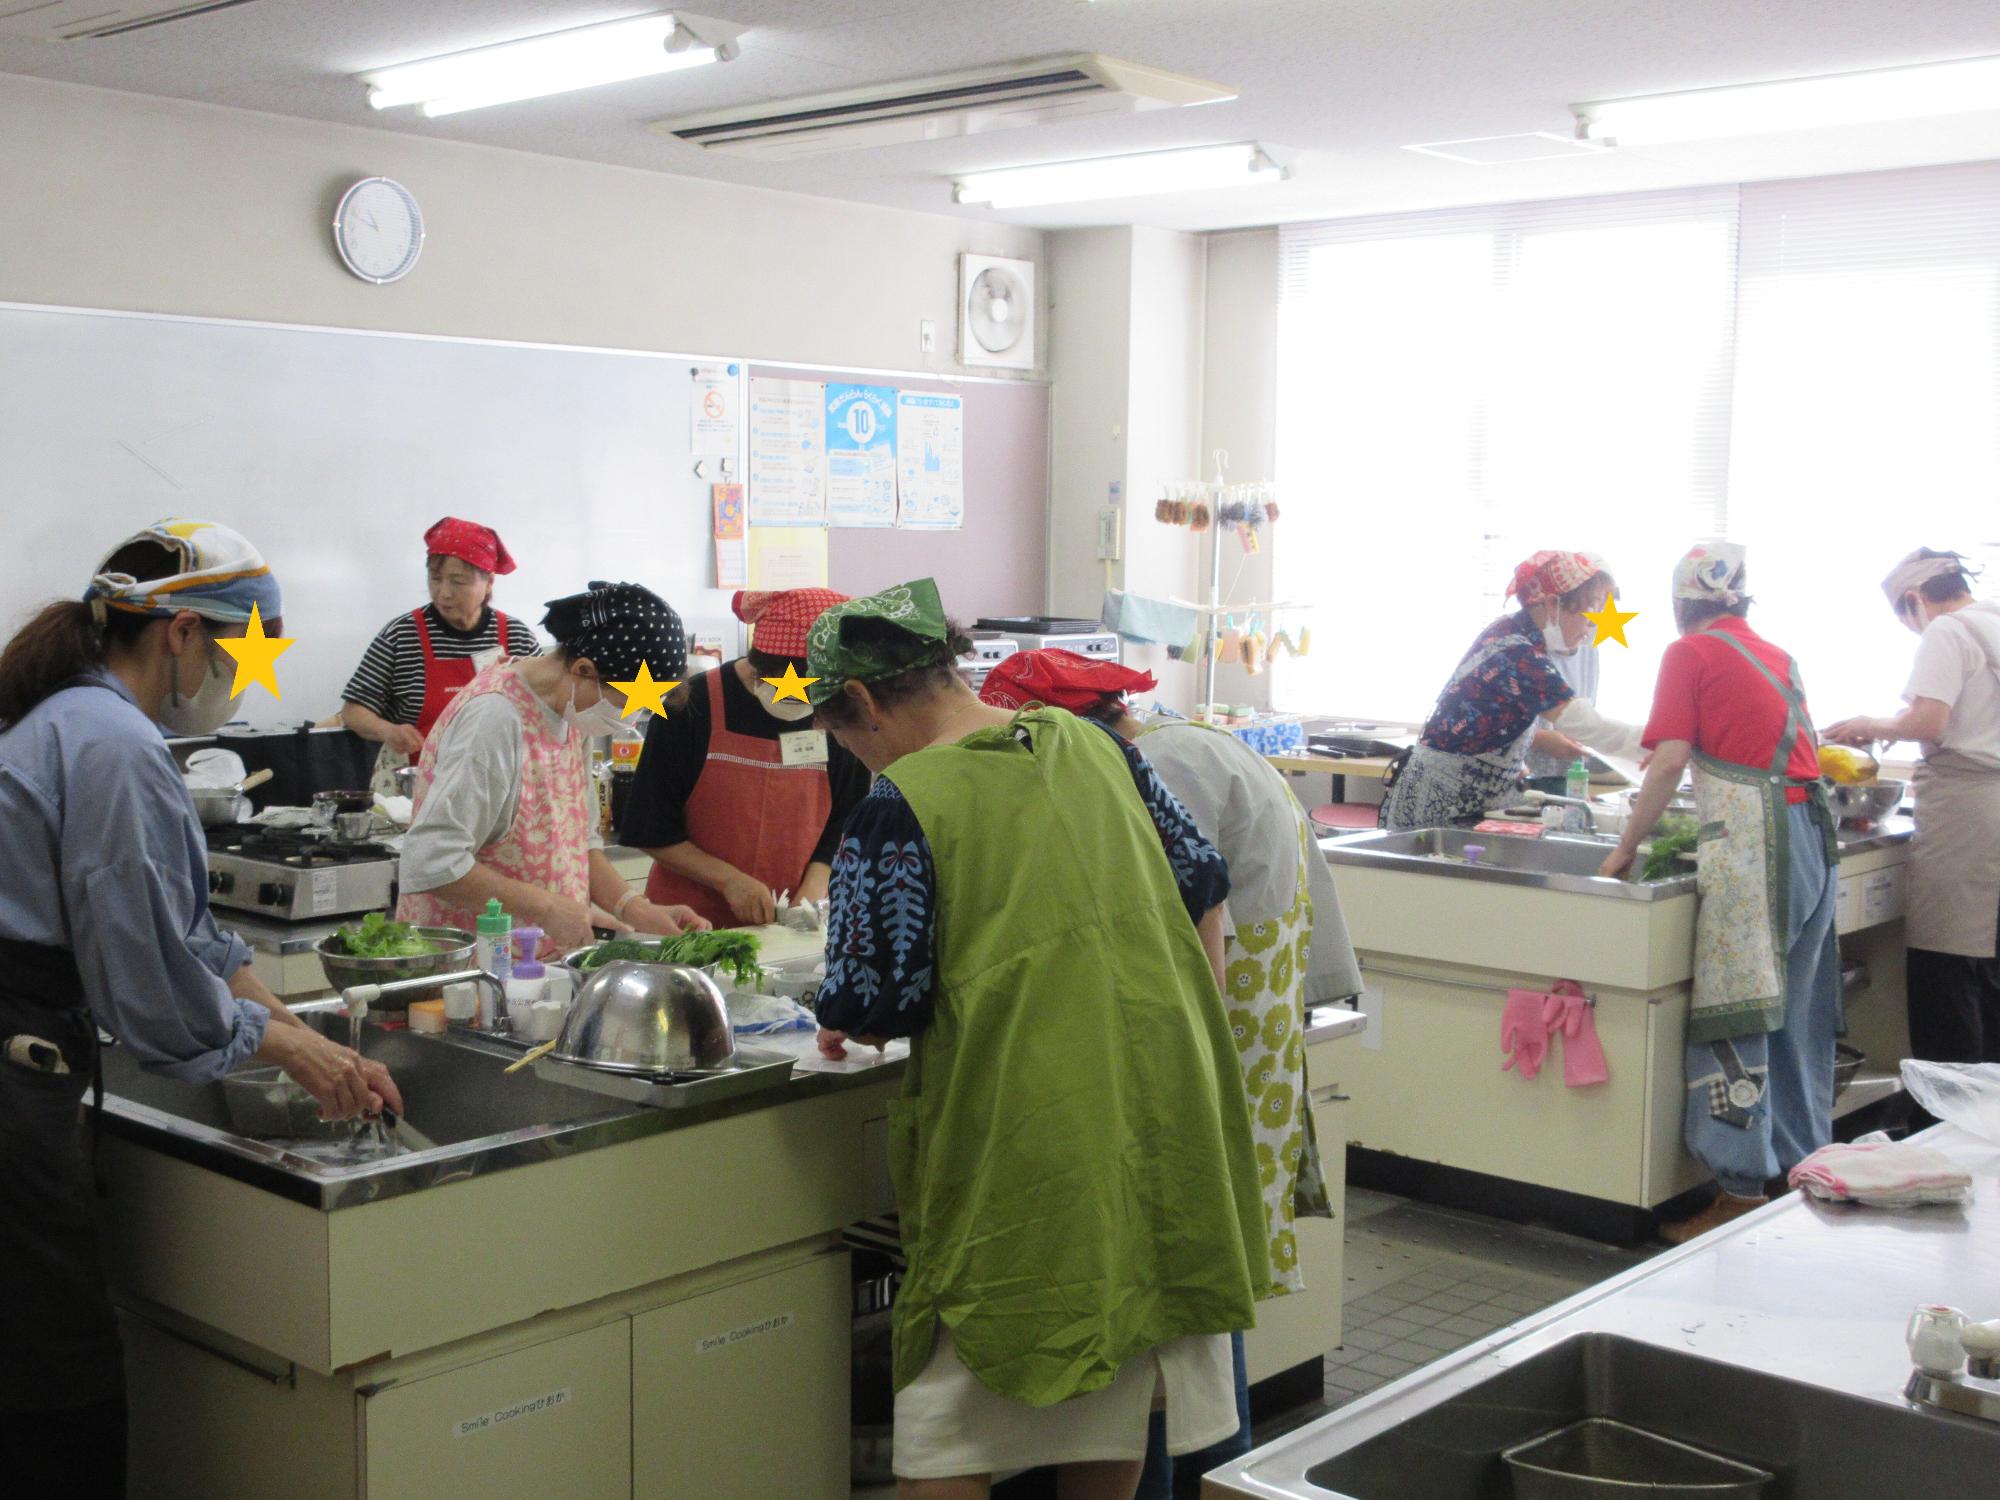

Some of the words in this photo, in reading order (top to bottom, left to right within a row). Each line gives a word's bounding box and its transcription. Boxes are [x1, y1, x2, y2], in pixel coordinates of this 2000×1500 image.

[853, 408, 869, 435] 10
[702, 1336, 726, 1352] Smile
[461, 1416, 489, 1433] Smile
